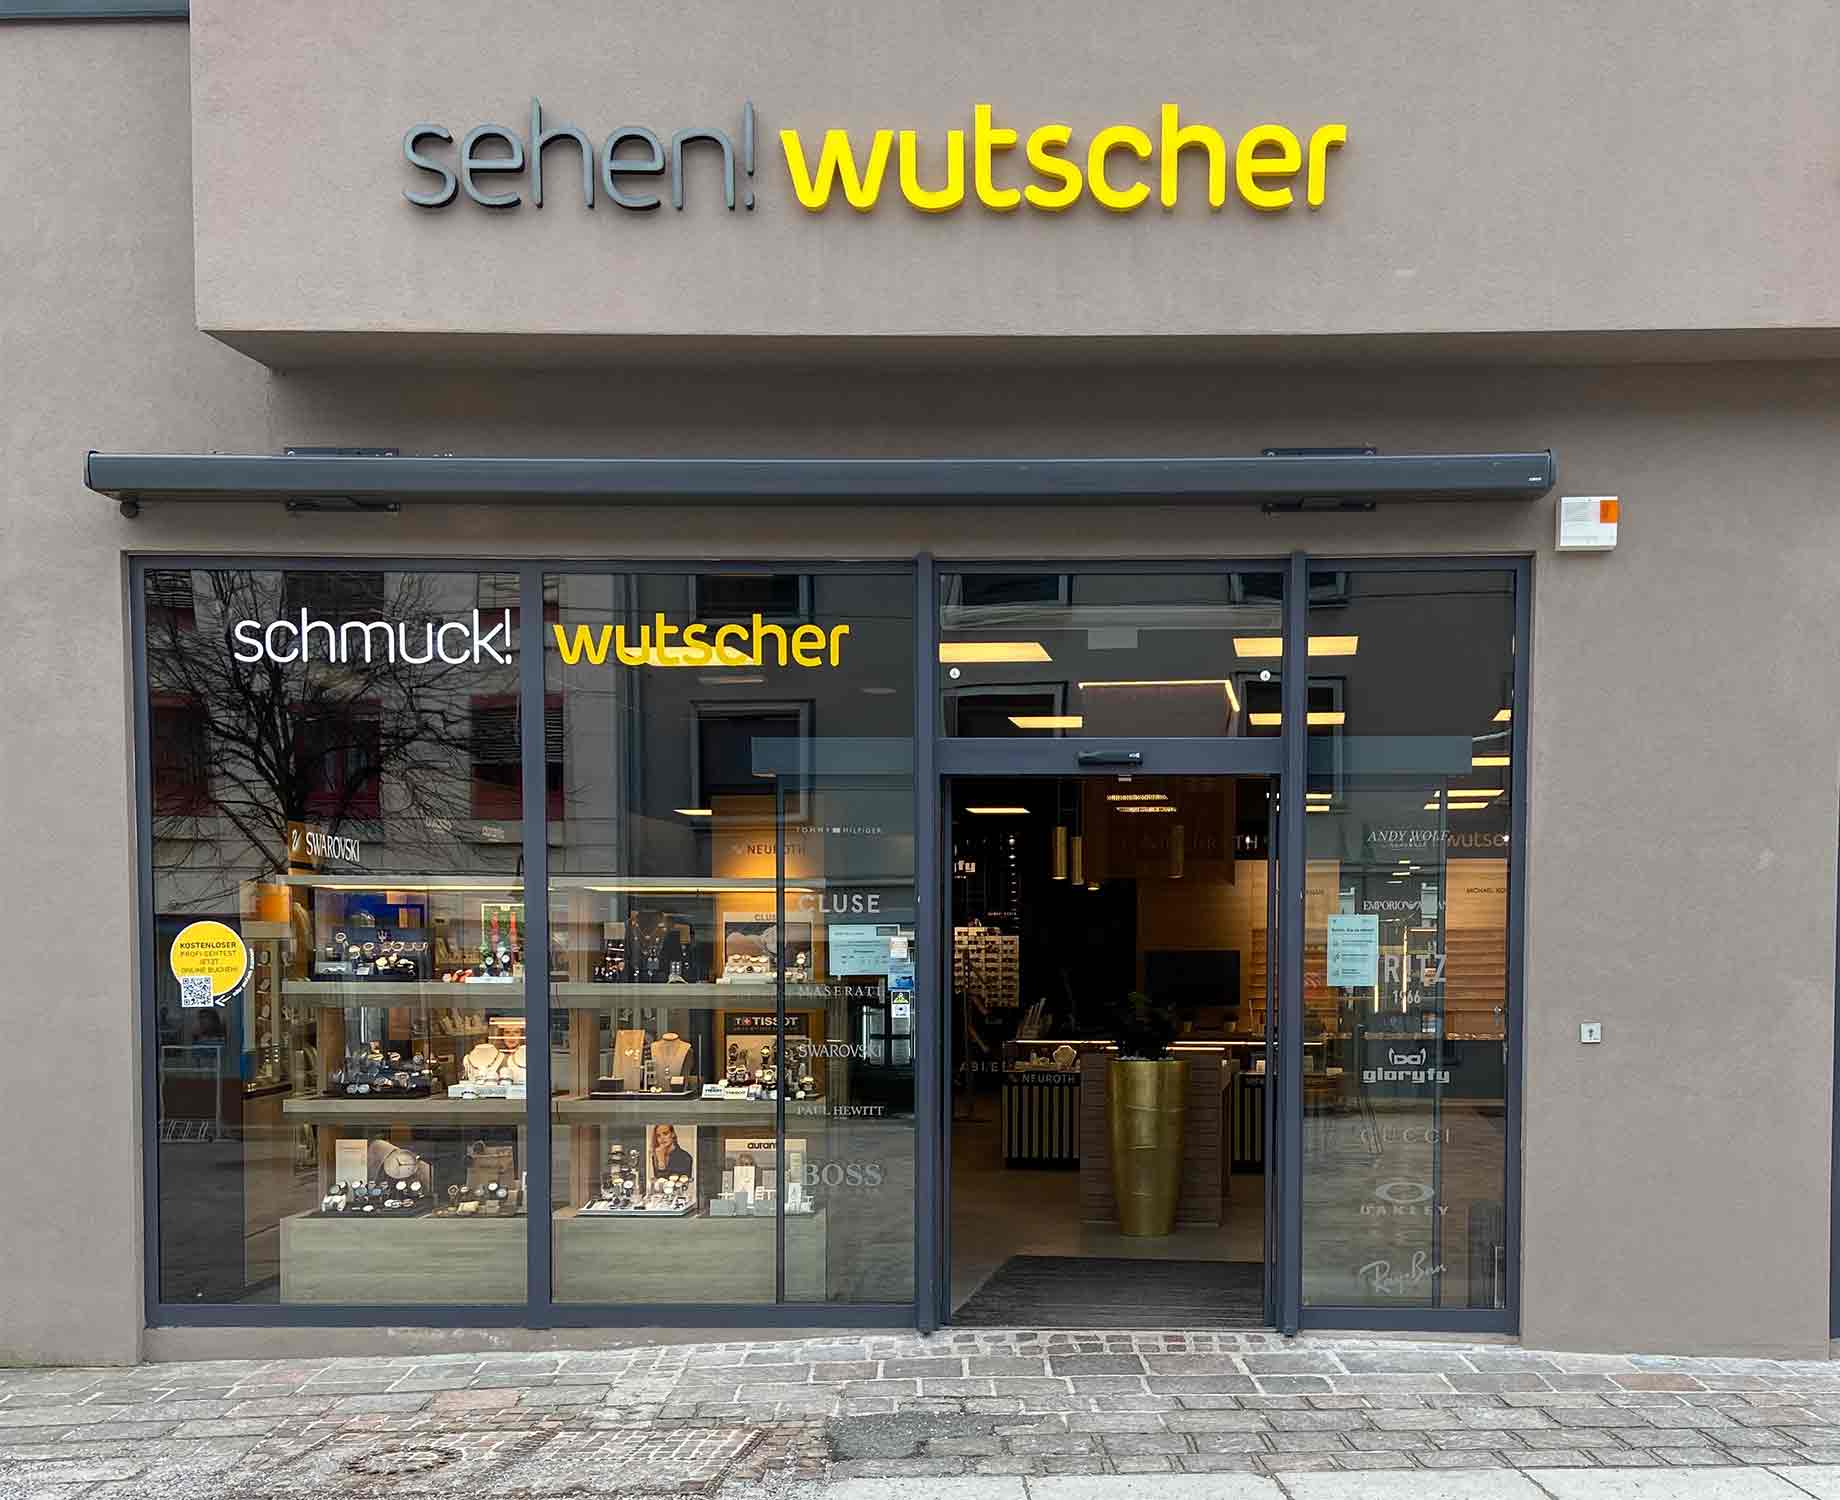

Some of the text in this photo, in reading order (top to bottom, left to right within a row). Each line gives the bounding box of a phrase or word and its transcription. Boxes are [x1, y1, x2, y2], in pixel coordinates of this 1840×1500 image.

[402, 97, 1348, 214] sehen! wutscher
[234, 607, 514, 666] schmuck!
[552, 612, 850, 667] wutscher
[1367, 830, 1450, 842] ANDY WOLF
[305, 831, 360, 862] SWAROVSKI
[798, 894, 881, 913] CLUSE
[1363, 901, 1404, 911] EMPORIO
[1384, 954, 1447, 983] RITZ
[799, 1044, 882, 1058] SWAROVSKI
[1022, 1073, 1075, 1084] NEUROTH
[1362, 1067, 1450, 1083] gloryfy
[834, 1106, 884, 1116] HEWITT
[801, 1164, 882, 1186] BOSS
